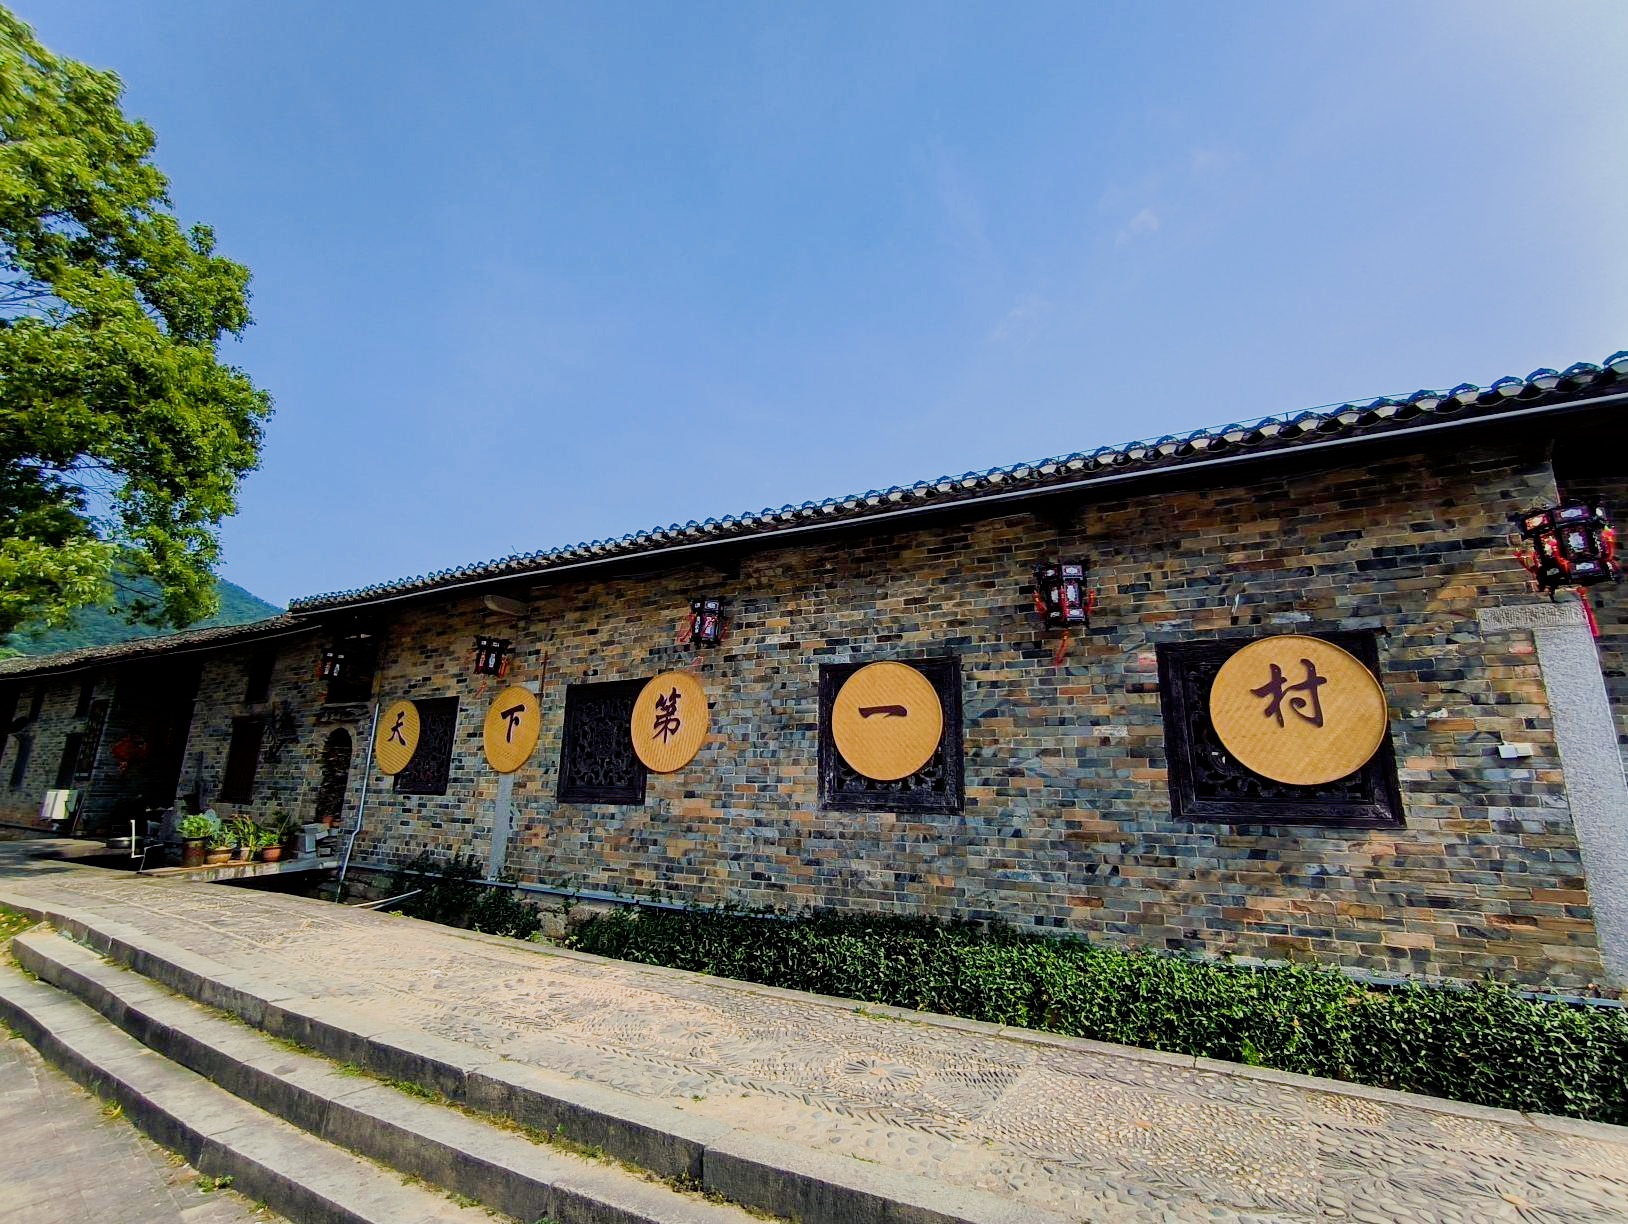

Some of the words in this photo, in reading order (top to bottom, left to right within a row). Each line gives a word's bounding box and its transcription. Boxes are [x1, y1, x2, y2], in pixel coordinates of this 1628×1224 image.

[858, 704, 908, 719] 一
[1250, 658, 1328, 729] 村
[386, 710, 406, 746] 天
[500, 704, 526, 743] 下
[651, 687, 682, 744] 第
